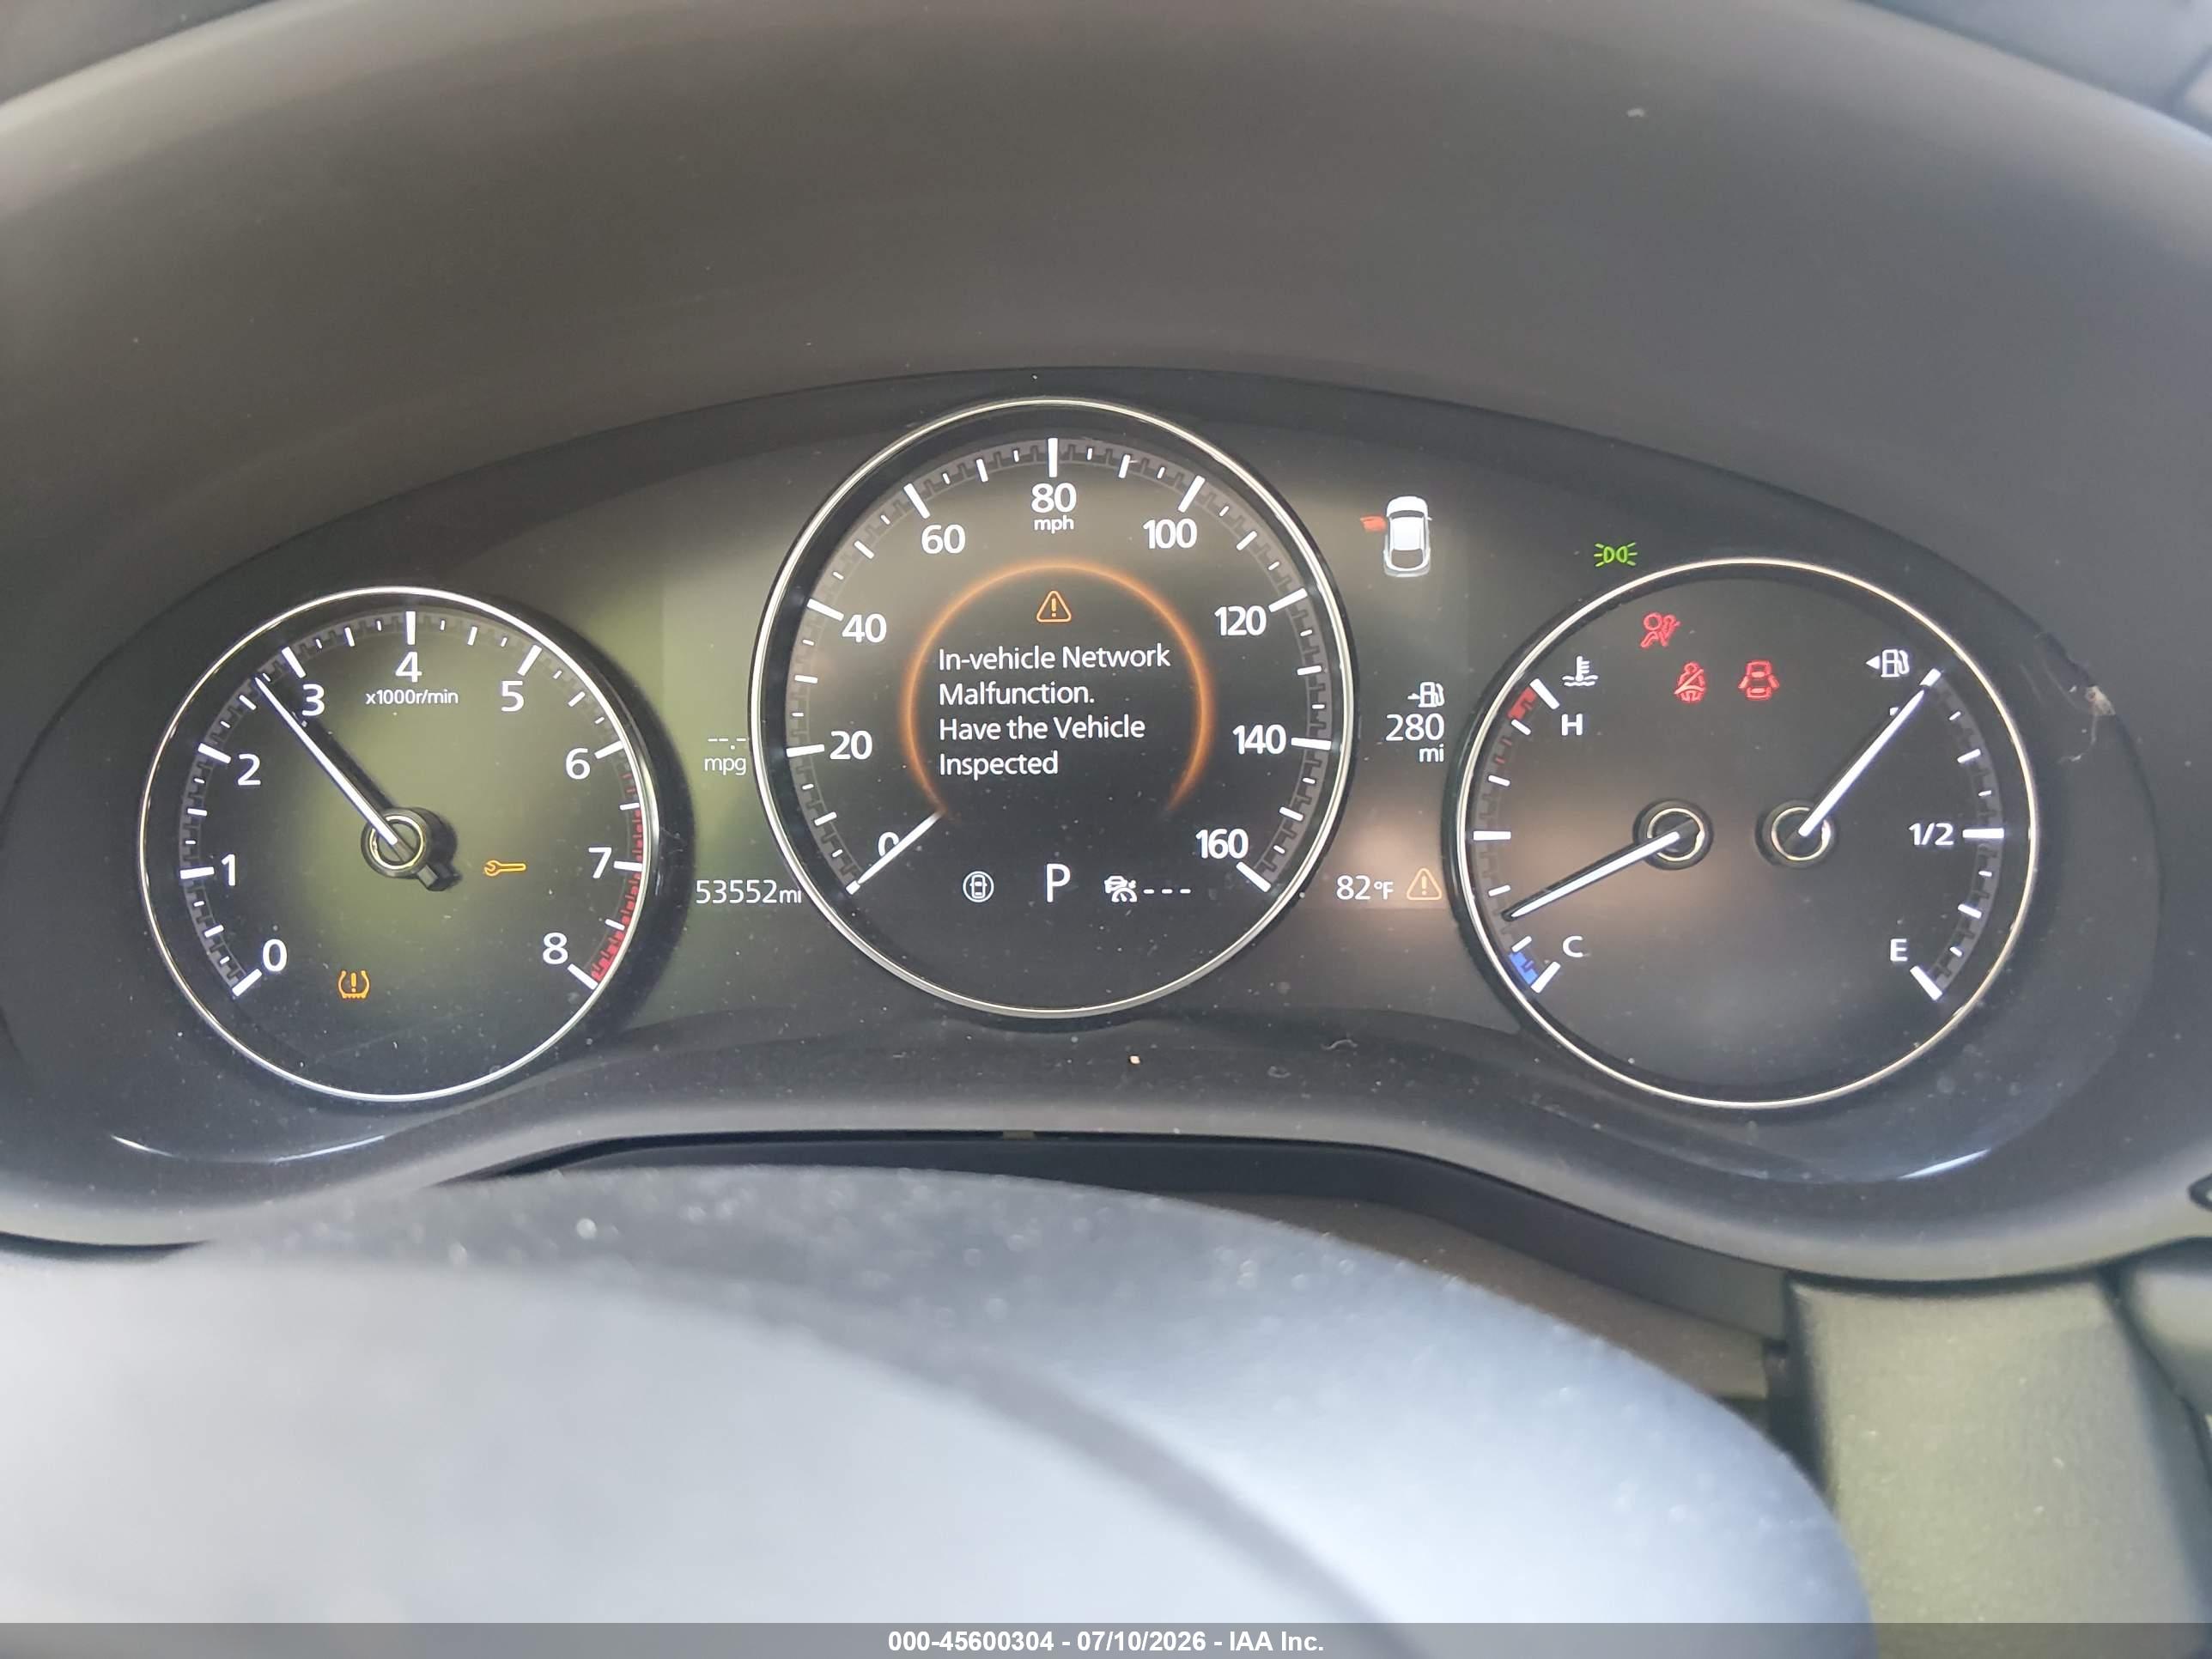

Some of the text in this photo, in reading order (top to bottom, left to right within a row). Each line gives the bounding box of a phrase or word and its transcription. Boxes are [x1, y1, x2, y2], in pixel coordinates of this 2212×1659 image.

[1030, 482, 1077, 514] 80
[921, 524, 966, 555] 60
[1034, 516, 1074, 534] mph
[1142, 518, 1198, 550] 100
[842, 612, 887, 643] 40
[1214, 605, 1267, 636] 120
[395, 651, 422, 683] 4
[939, 642, 1171, 671] In-vehicle Network
[302, 683, 325, 717] 3
[365, 689, 459, 705] x1000r/min
[501, 680, 525, 712] 5
[939, 680, 1095, 706] Malfunction.
[939, 714, 1146, 740] Have the Vehicle
[1232, 724, 1287, 755] 140
[1385, 713, 1445, 741] 280
[1561, 713, 1583, 736] H
[830, 730, 873, 760] 20
[1419, 743, 1444, 763] mi
[237, 753, 261, 786] 2
[565, 747, 591, 780] 6
[704, 757, 747, 776] mpg
[939, 750, 1059, 781] Inspected
[1195, 828, 1249, 860] 160
[1908, 822, 1954, 846] 1/2
[221, 854, 236, 886] 1
[588, 847, 612, 879] 7
[1046, 863, 1071, 903] P
[262, 939, 288, 973] 0
[542, 932, 568, 965] 8
[1562, 935, 1584, 958] C
[1889, 938, 1908, 963] E
